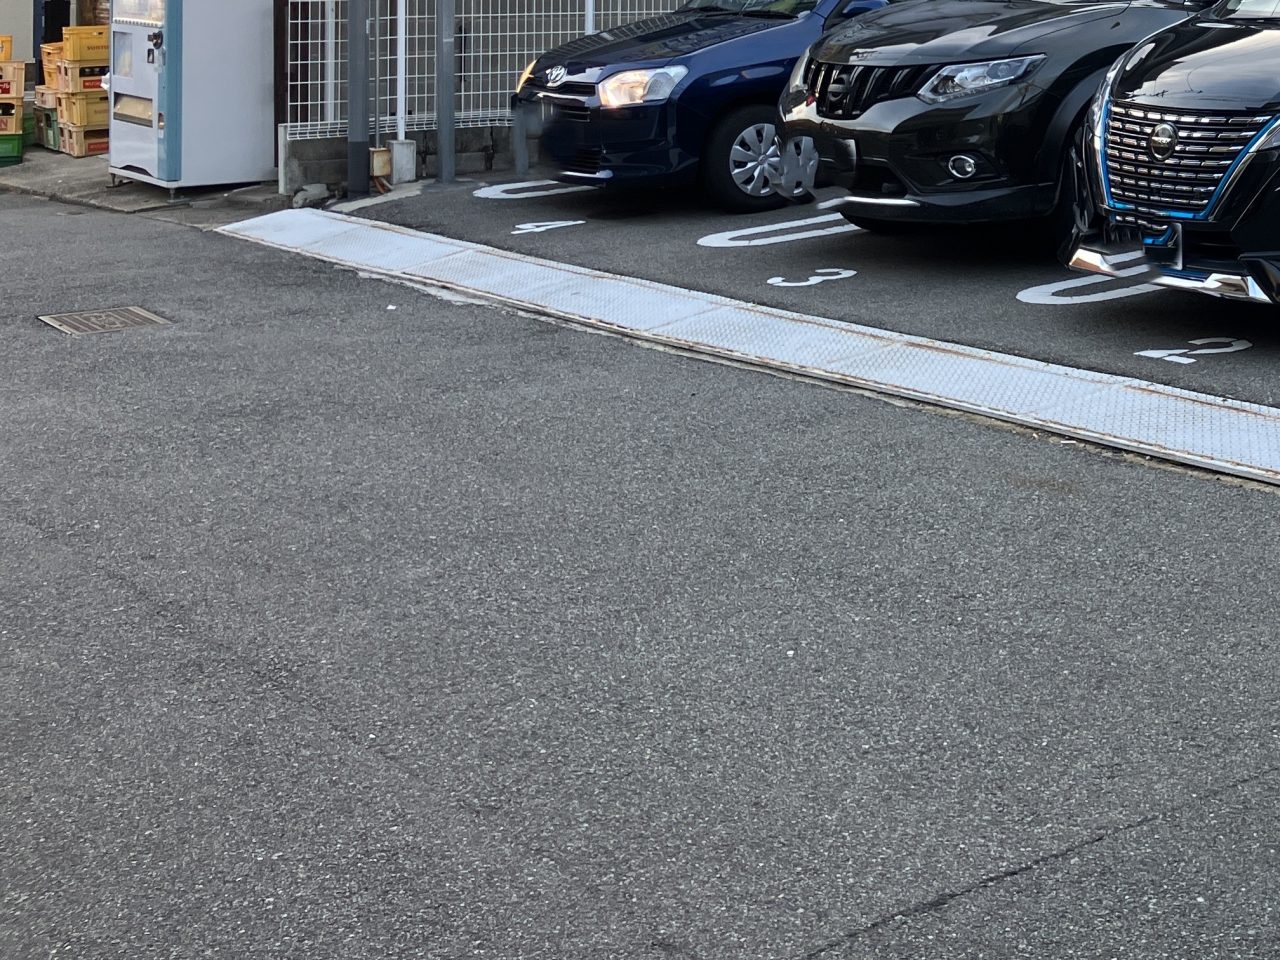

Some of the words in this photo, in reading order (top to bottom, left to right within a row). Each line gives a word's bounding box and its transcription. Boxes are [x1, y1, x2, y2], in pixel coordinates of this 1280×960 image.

[510, 220, 587, 235] 4
[766, 268, 858, 287] 3
[1133, 337, 1253, 364] 2
